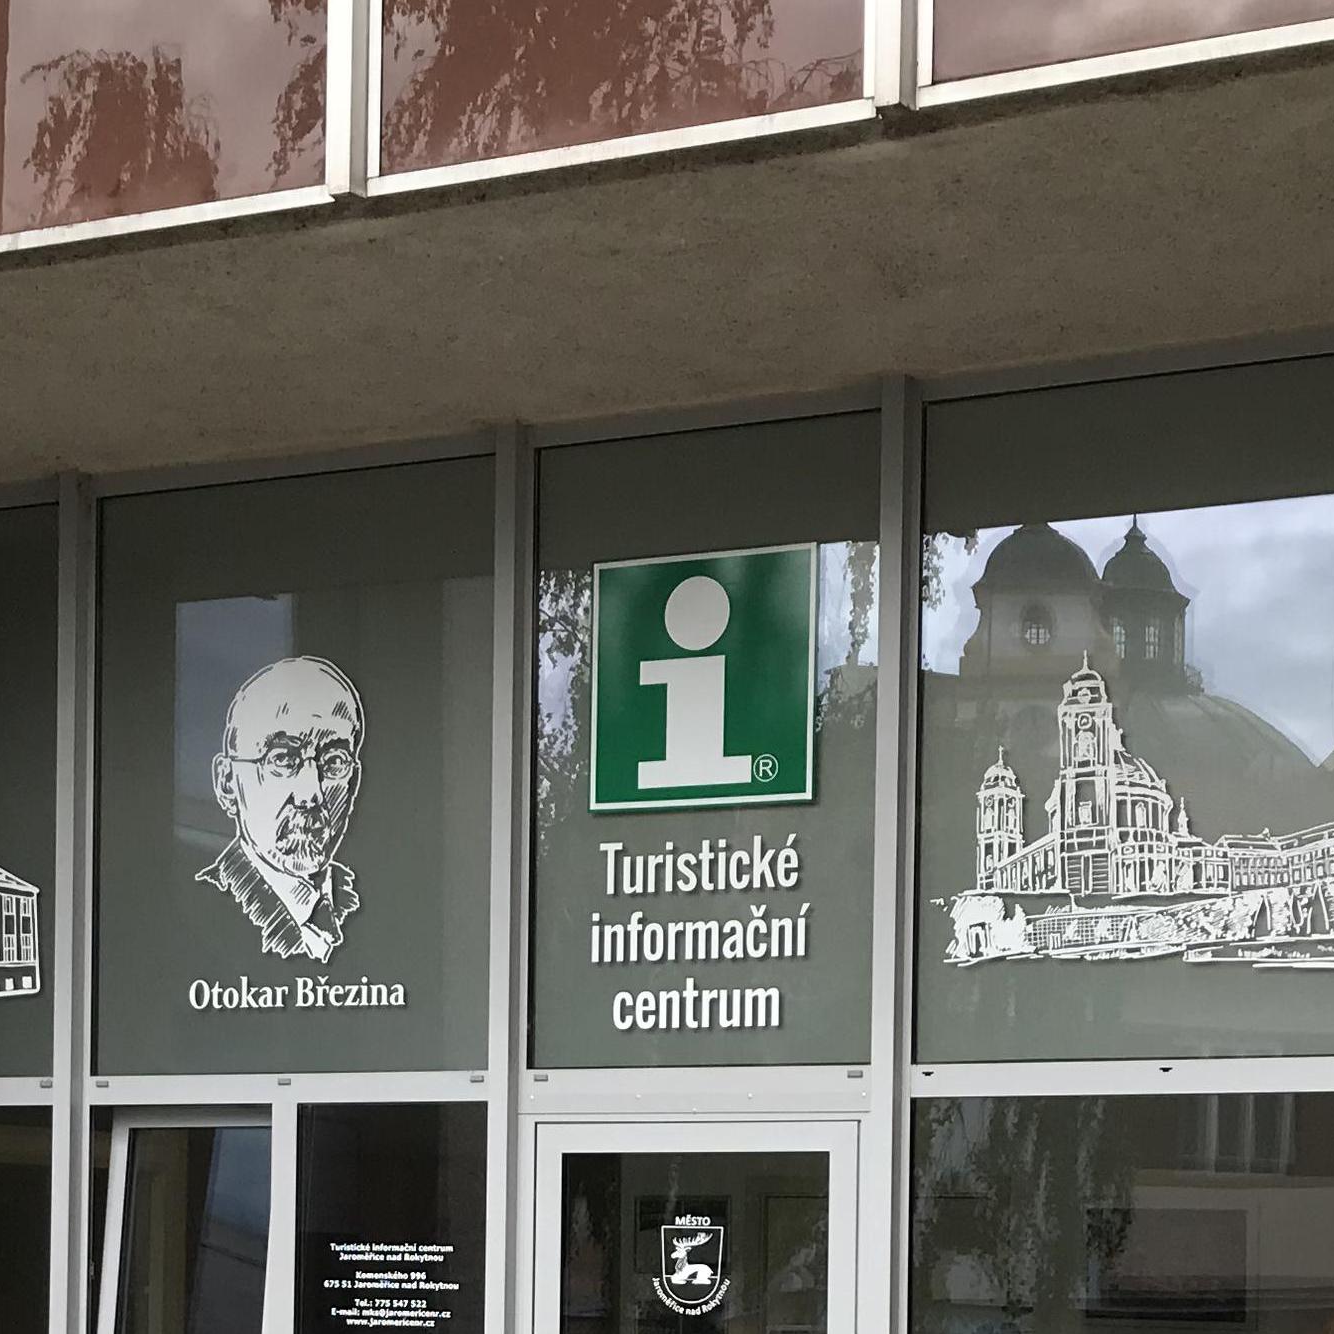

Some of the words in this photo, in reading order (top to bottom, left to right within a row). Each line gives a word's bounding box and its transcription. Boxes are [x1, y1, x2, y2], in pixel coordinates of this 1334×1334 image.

[637, 575, 752, 790] i
[600, 833, 800, 896] Turistické
[590, 902, 812, 963] informační
[188, 975, 289, 1010] Otokar
[295, 975, 406, 1008] Březina
[613, 976, 781, 1030] centrum
[674, 1214, 711, 1226] MĚSTO
[330, 1243, 371, 1252] Turistické
[418, 1244, 454, 1253] centrum
[386, 1253, 402, 1261] nad
[403, 1252, 444, 1263] Rokytnou
[355, 1270, 409, 1280] Komenského
[323, 1279, 340, 1289] 675
[341, 1279, 352, 1289] 51
[401, 1281, 417, 1290] nad
[419, 1281, 460, 1291] Rokytnou
[374, 1298, 391, 1308] 775
[392, 1299, 409, 1308] 547
[410, 1299, 427, 1309] 522
